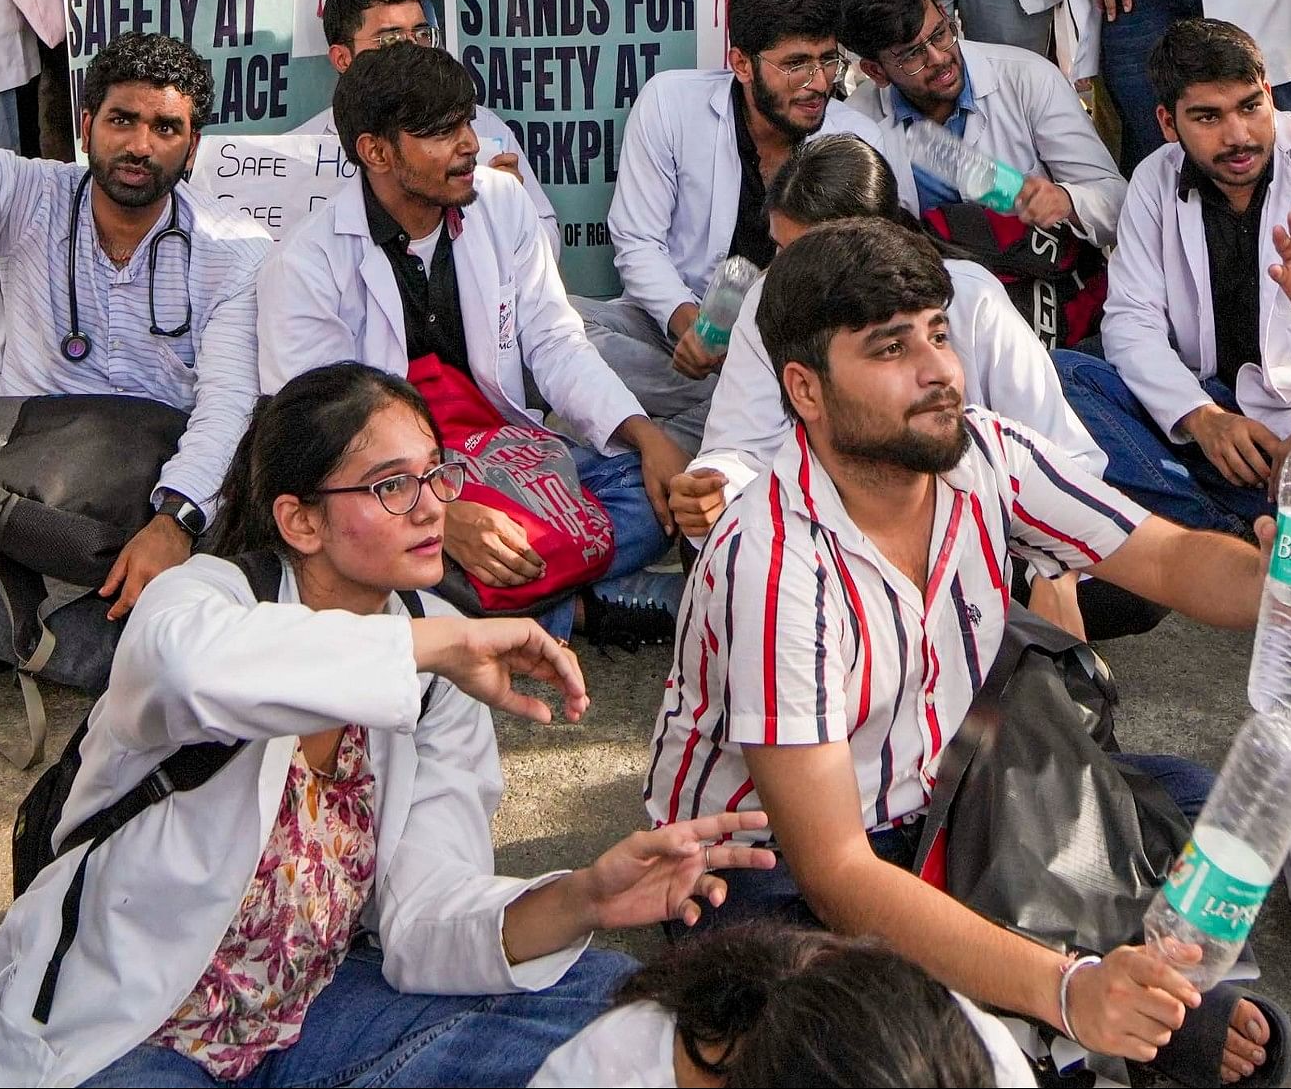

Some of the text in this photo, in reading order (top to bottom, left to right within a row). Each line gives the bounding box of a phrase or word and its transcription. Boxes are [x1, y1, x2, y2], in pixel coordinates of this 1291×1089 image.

[462, 42, 661, 112] SAFETY AT
[217, 143, 358, 179] SAFE HO
[511, 119, 618, 186] ORKPL
[564, 223, 582, 247] OF
